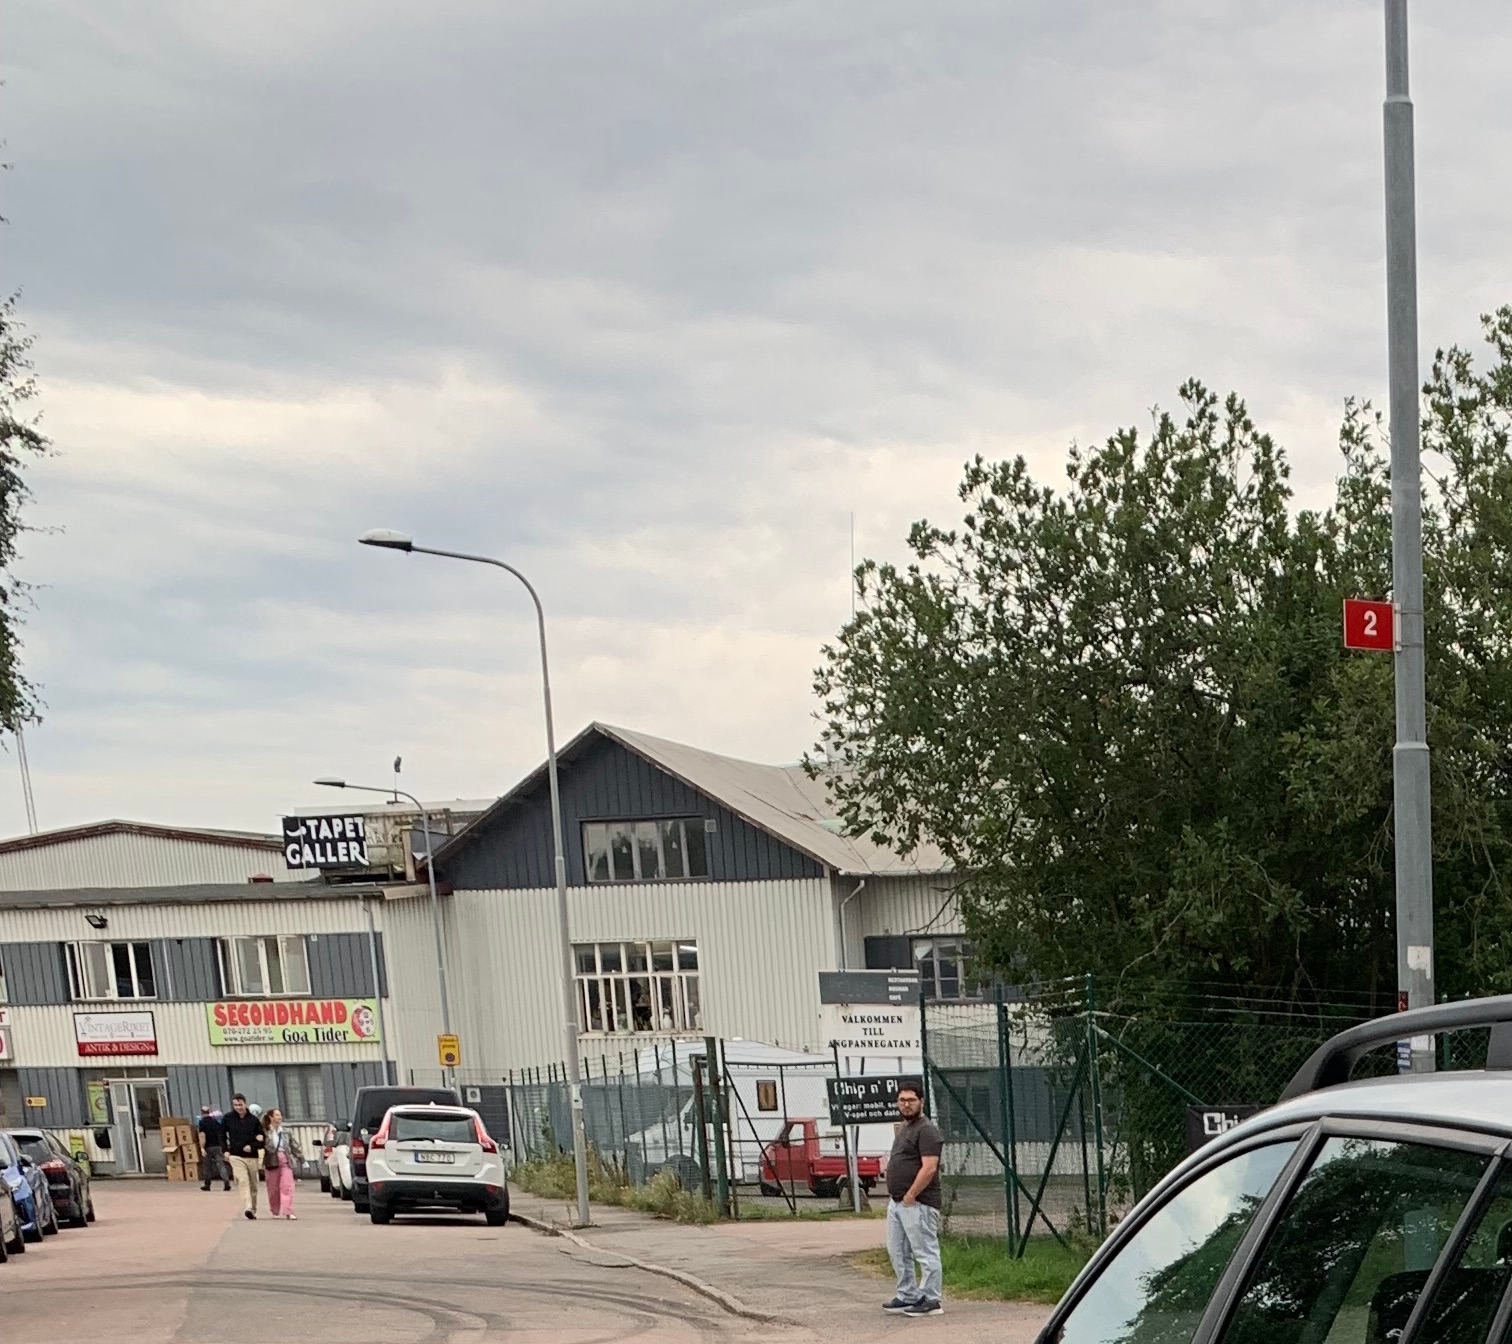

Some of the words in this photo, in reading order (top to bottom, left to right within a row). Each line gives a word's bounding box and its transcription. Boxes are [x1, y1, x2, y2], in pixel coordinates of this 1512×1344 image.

[1363, 610, 1378, 636] 2
[305, 816, 364, 840] TAPET
[286, 840, 370, 866] GALLERI
[213, 1000, 347, 1027] SECONDHAND
[282, 1027, 308, 1042] Goa
[313, 1026, 349, 1042] Tider
[862, 1027, 885, 1036] TILL
[85, 1043, 110, 1052] ANTIK
[1203, 1112, 1239, 1135] Chi
